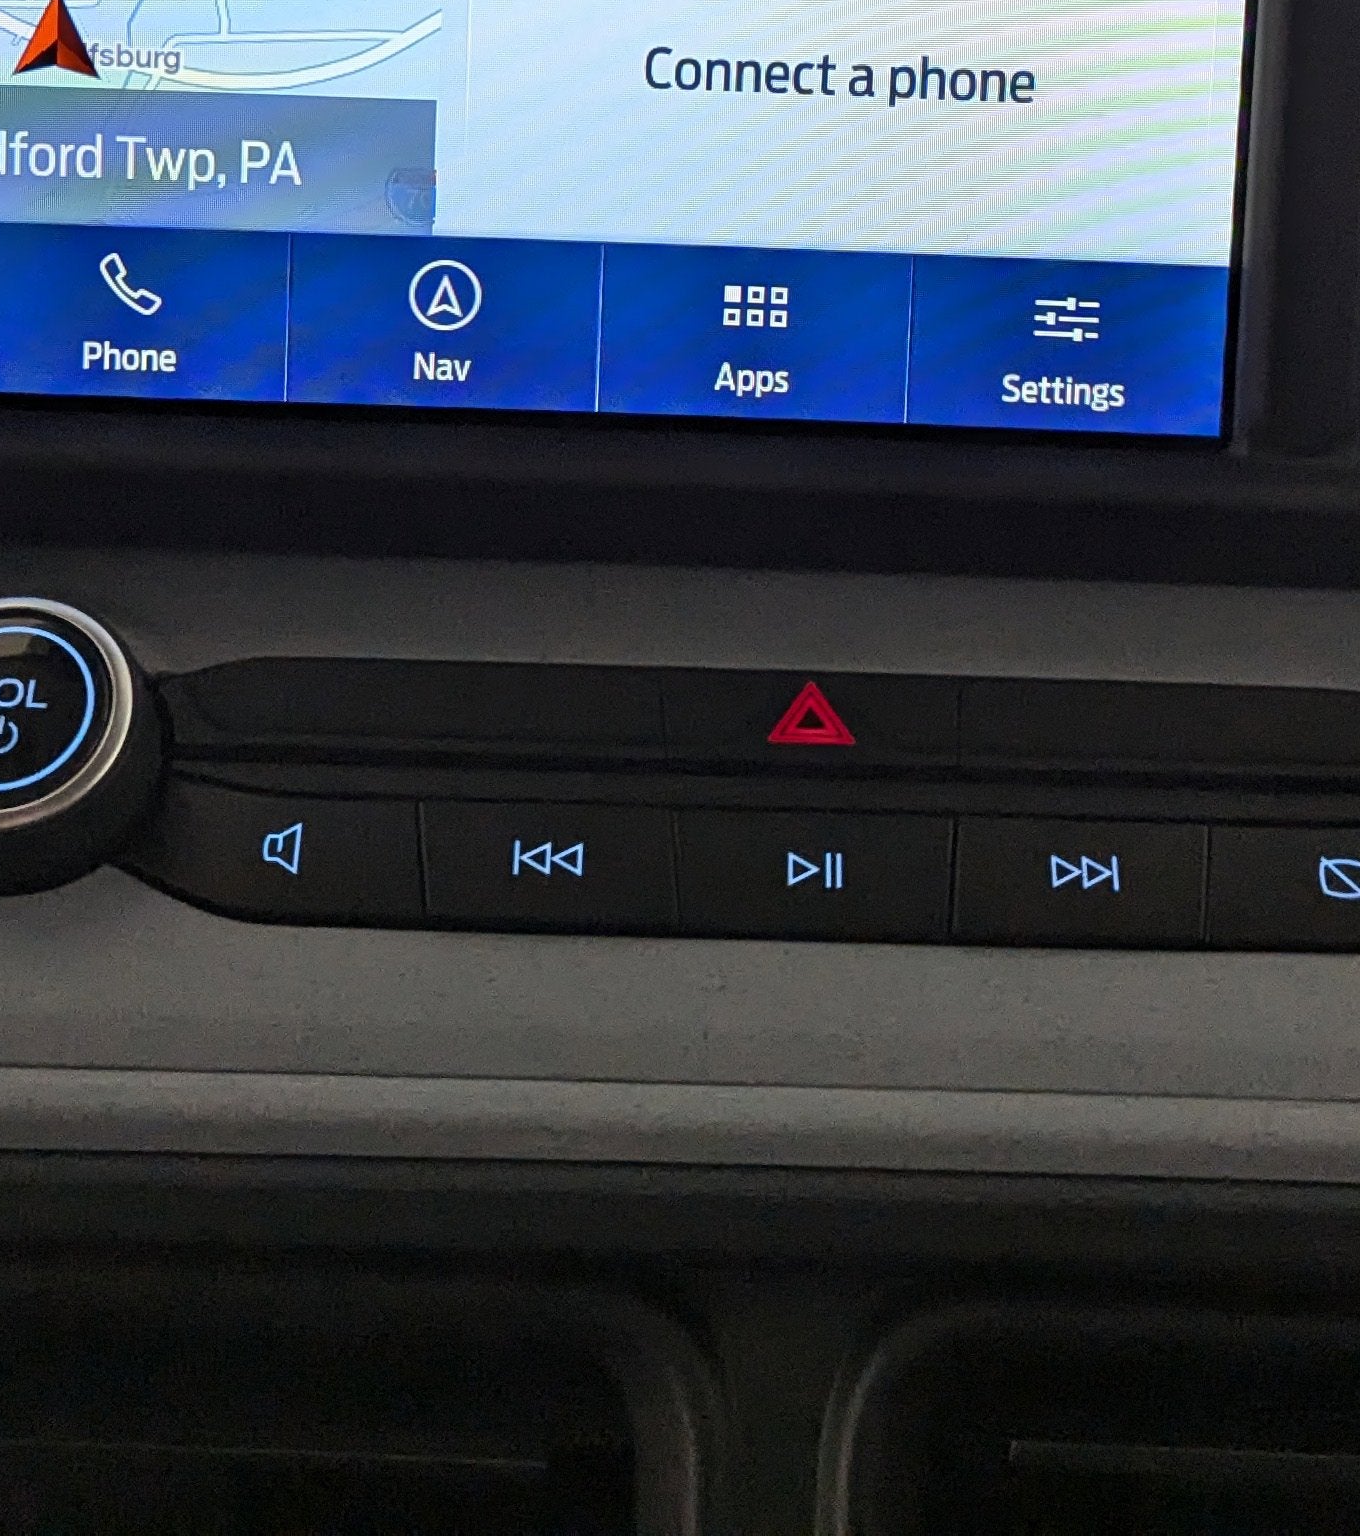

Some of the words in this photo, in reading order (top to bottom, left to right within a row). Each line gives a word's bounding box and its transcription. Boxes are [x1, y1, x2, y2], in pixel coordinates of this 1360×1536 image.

[644, 46, 838, 96] Connect
[847, 61, 876, 97] a
[887, 56, 1036, 106] phone
[115, 135, 226, 190] Twp,
[240, 142, 302, 186] PA
[82, 340, 177, 373] Phone
[413, 353, 472, 383] Nav
[714, 361, 789, 396] Apps
[1001, 373, 1125, 412] Settings
